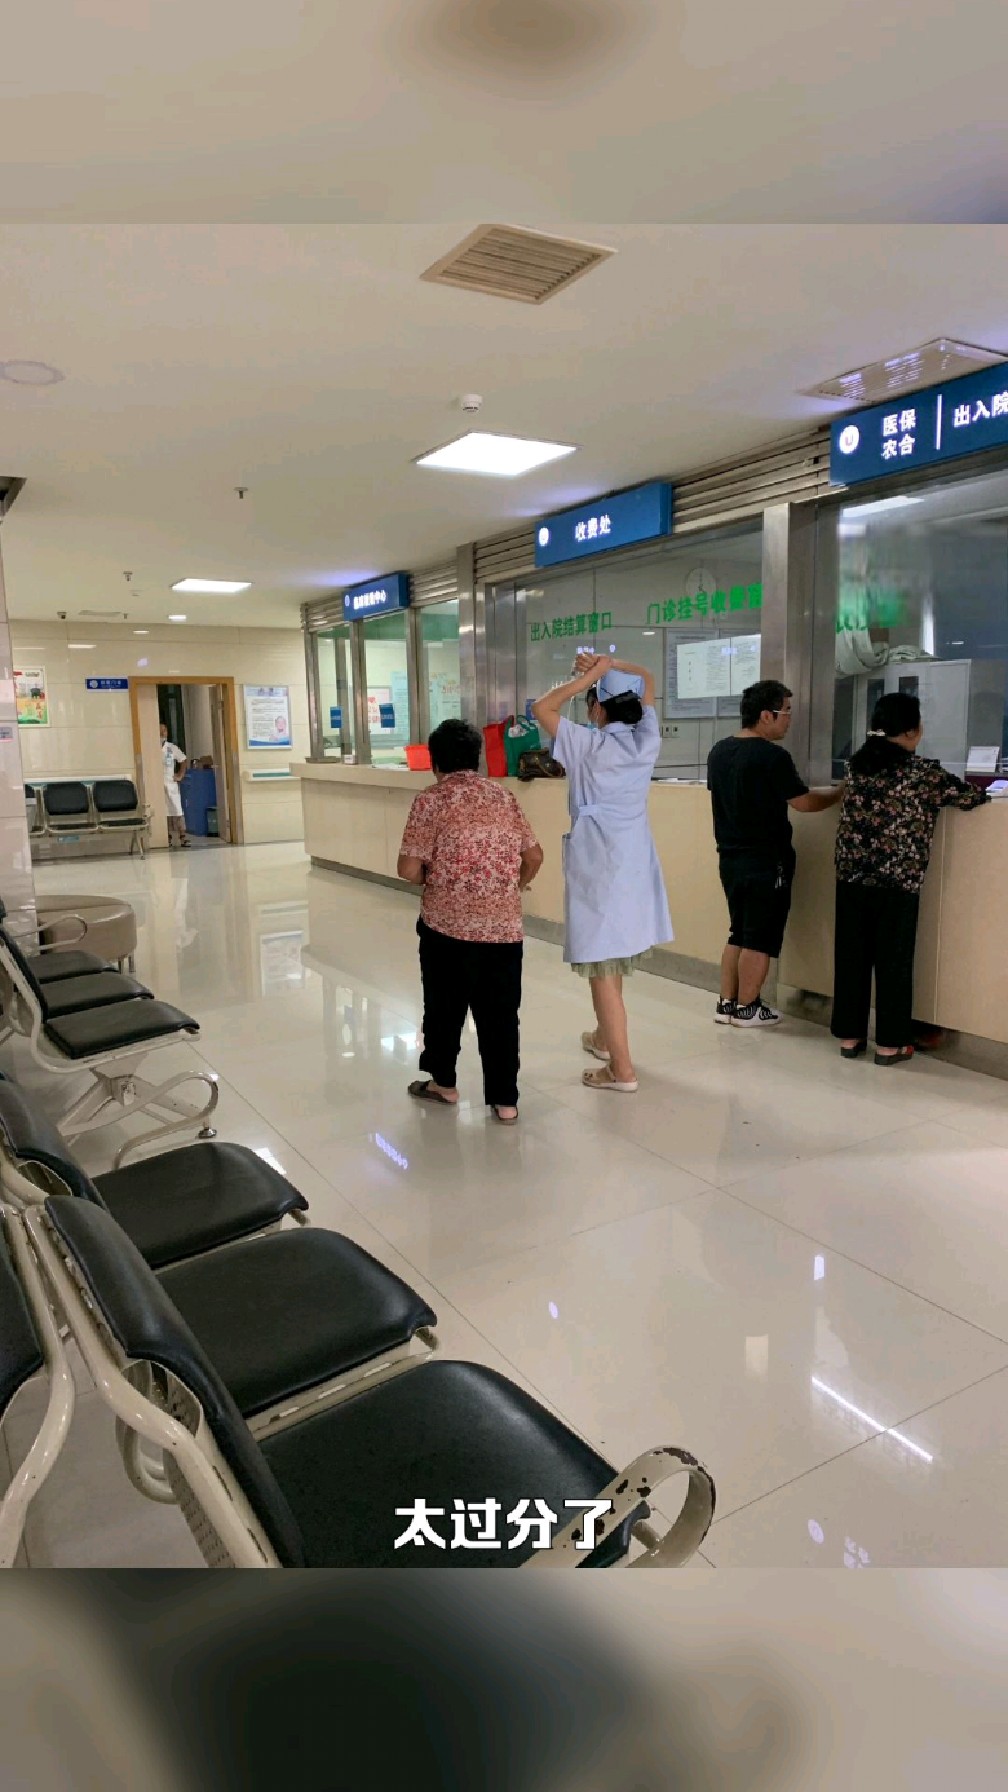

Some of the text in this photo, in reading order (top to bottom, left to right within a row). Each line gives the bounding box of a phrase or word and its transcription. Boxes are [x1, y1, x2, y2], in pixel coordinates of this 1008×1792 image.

[882, 408, 916, 437] 医保
[953, 390, 1008, 428] 出入院
[881, 433, 916, 461] 农合
[574, 514, 611, 543] 收费处
[530, 612, 612, 642] 出入院结算窗口
